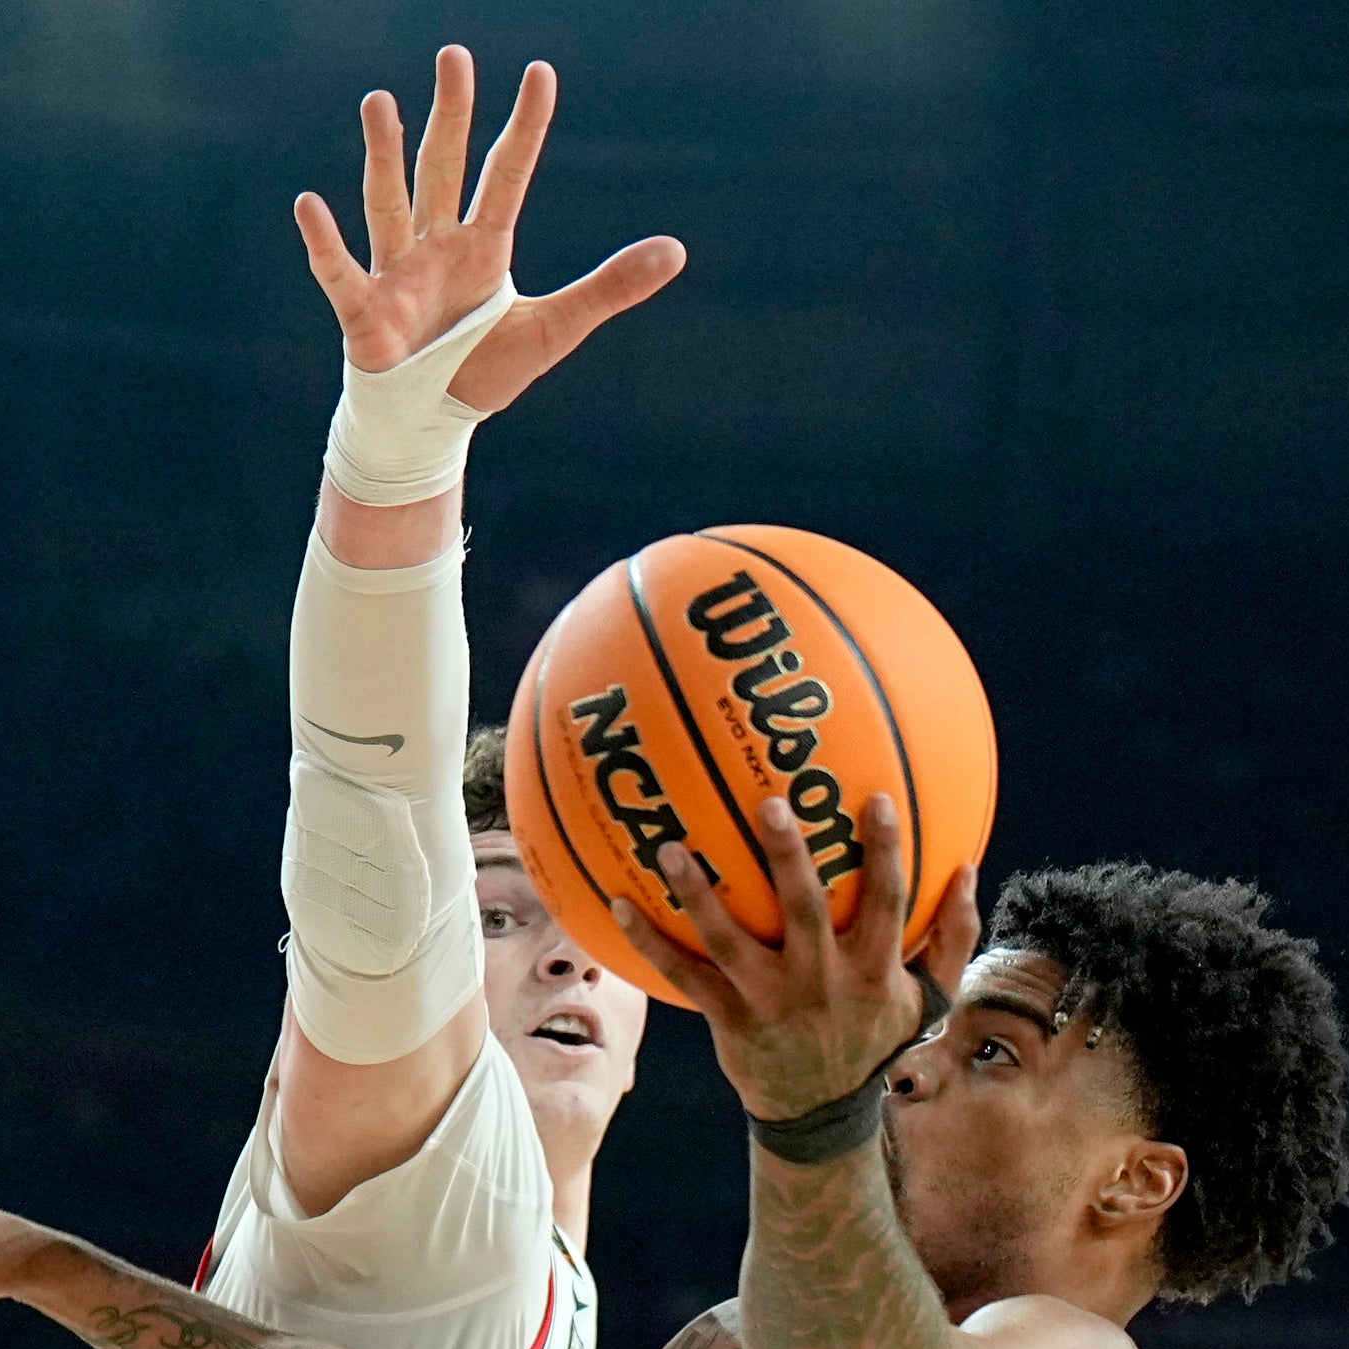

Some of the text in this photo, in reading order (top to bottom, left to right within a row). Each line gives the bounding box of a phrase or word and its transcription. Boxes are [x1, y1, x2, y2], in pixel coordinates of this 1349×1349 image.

[685, 570, 864, 888] Wilson
[716, 695, 771, 787] EVO NXT
